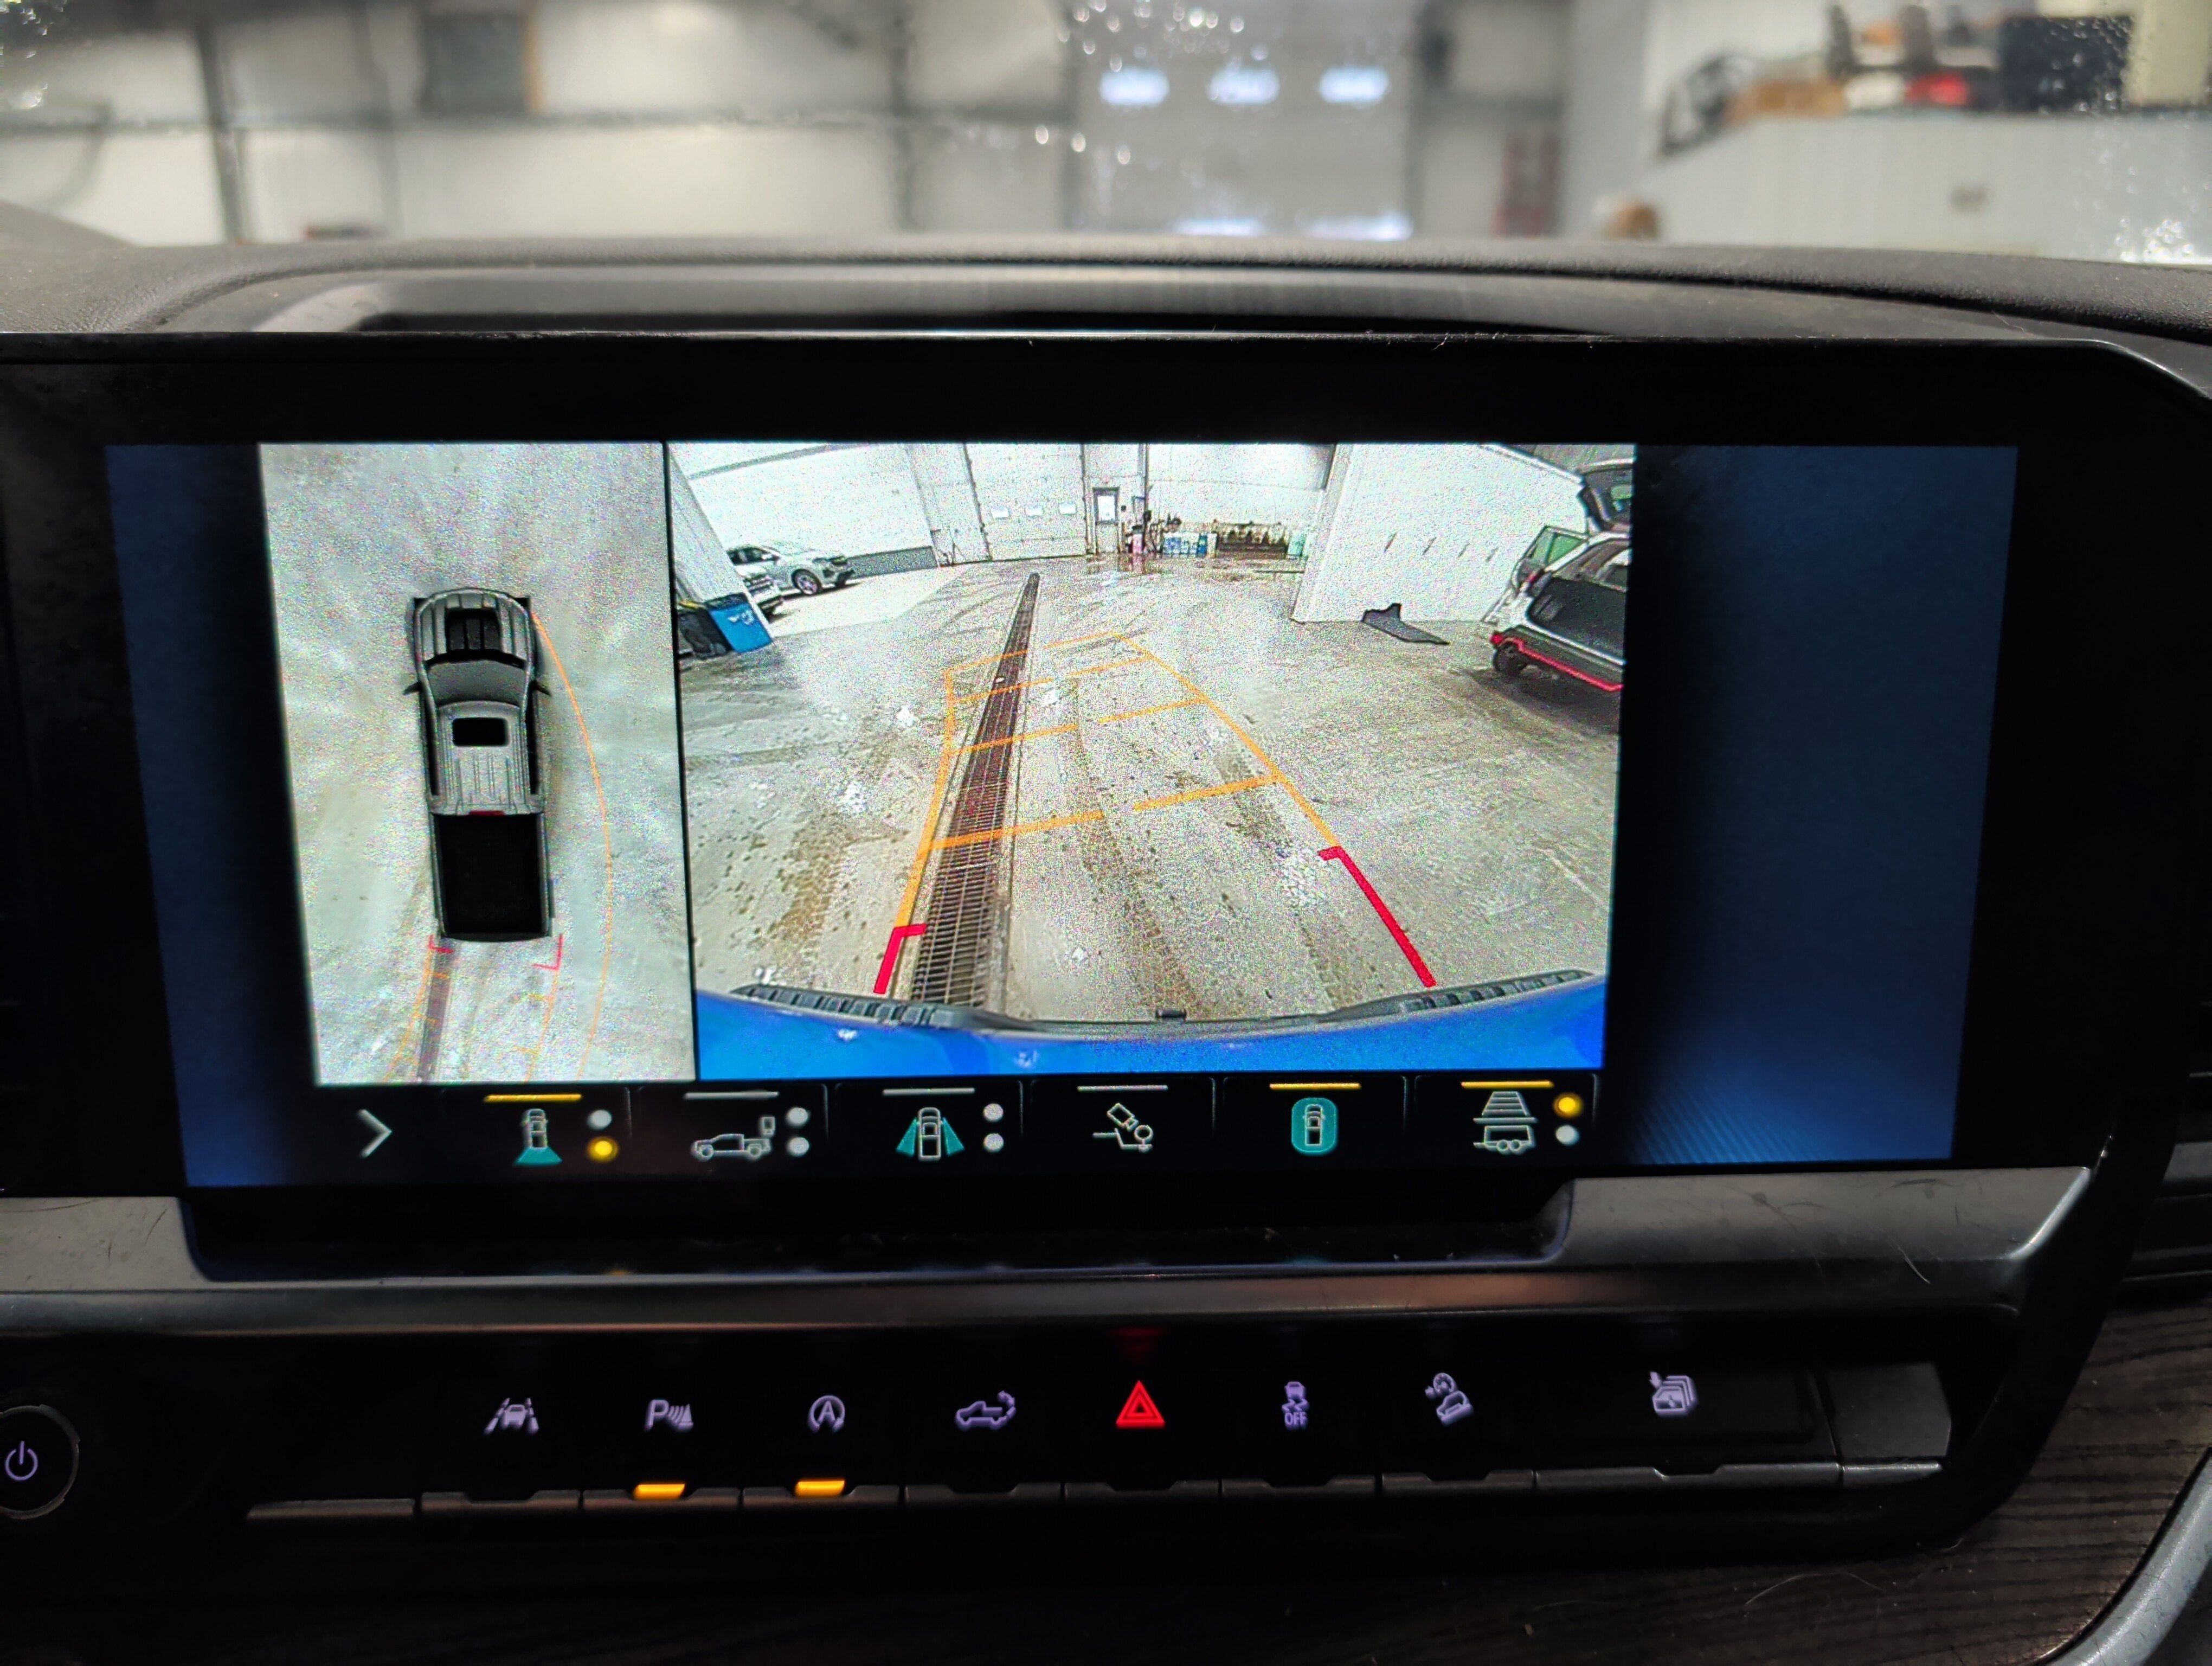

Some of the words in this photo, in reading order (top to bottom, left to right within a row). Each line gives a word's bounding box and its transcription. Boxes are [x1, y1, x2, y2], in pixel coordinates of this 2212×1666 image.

[647, 1399, 670, 1430] P
[817, 1400, 836, 1424] A
[1284, 1411, 1307, 1426] OFF
